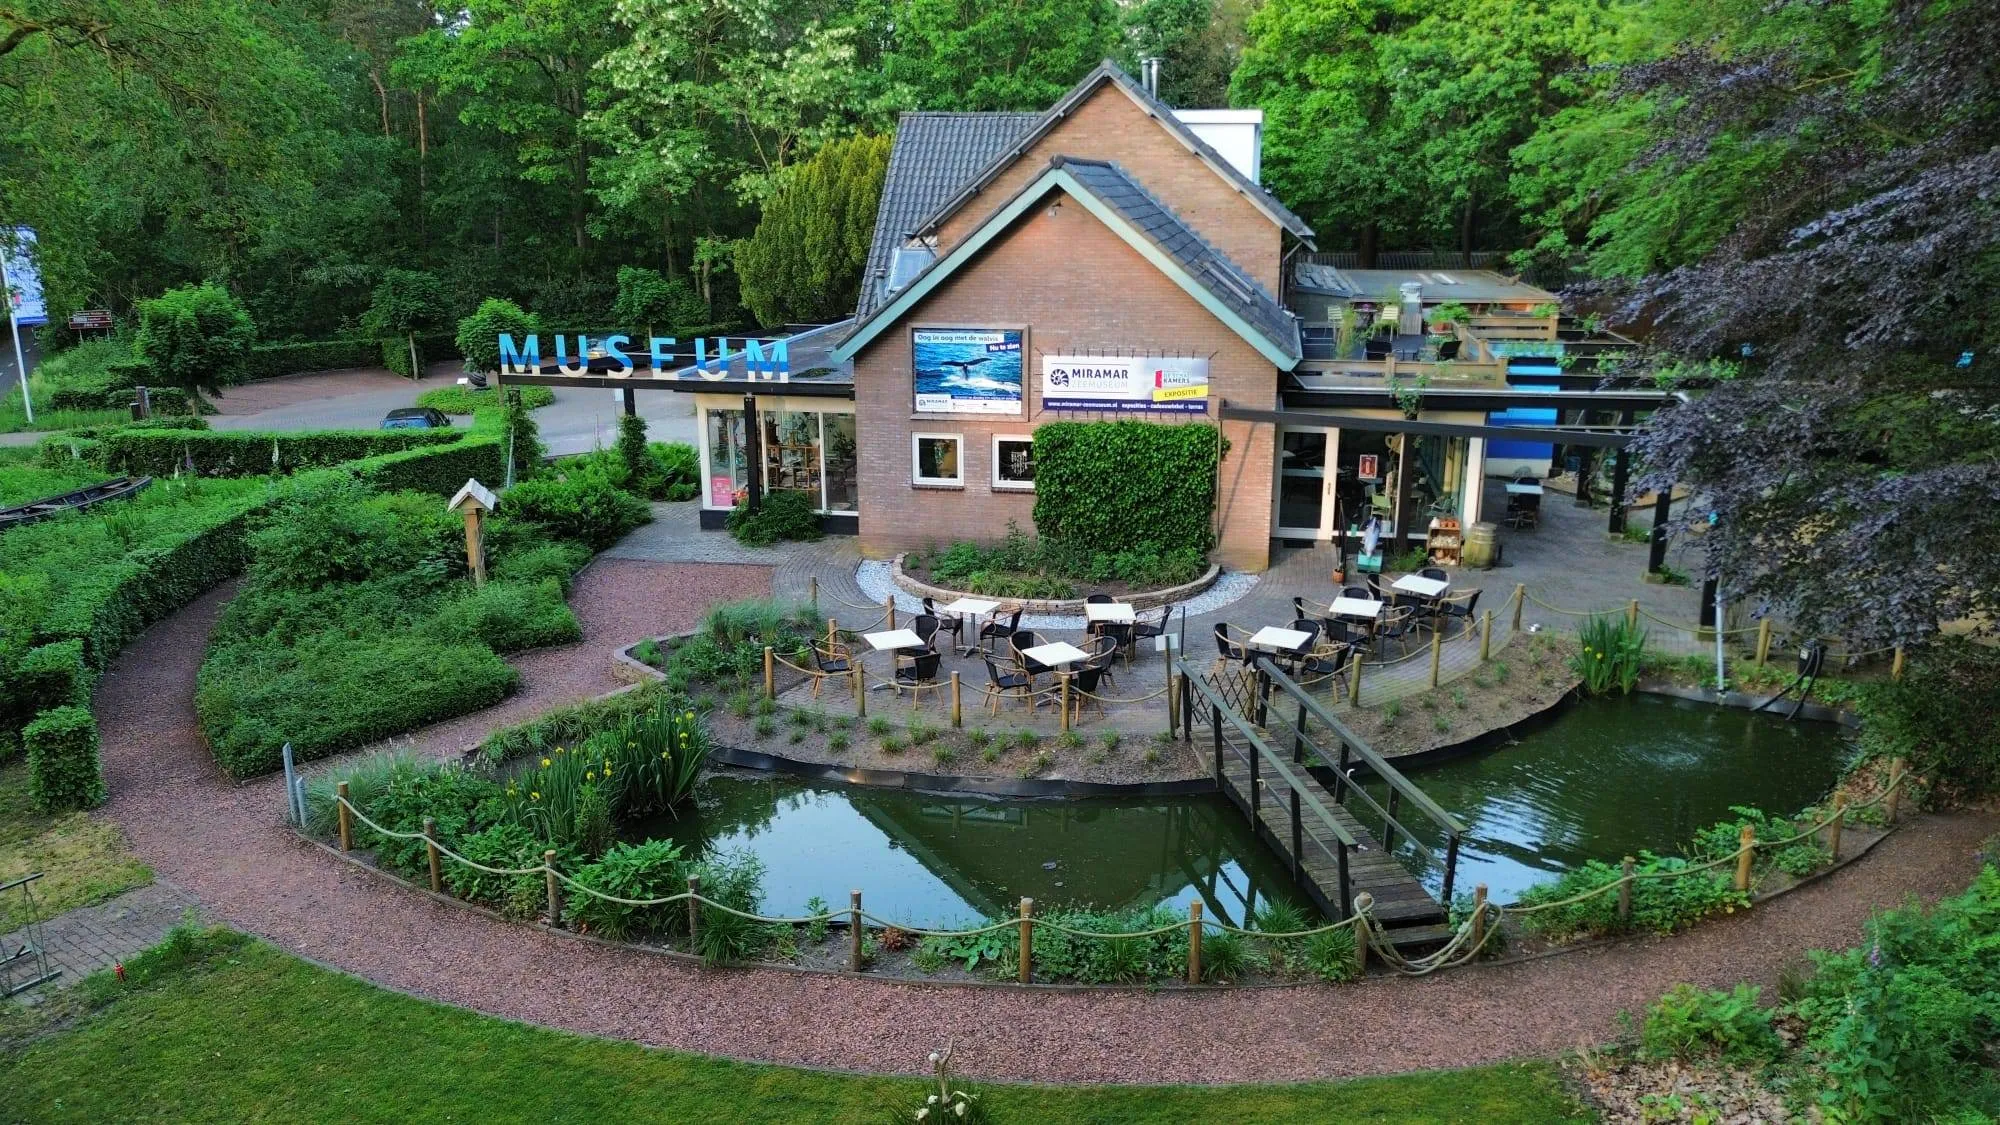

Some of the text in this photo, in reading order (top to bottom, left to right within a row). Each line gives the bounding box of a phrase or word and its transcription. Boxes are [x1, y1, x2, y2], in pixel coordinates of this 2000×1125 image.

[498, 333, 789, 384] MUSEUM
[1072, 368, 1129, 379] MIRAMAR
[1072, 379, 1128, 389] ZEEMUSEUM
[1164, 389, 1197, 398] EXPOSITIE
